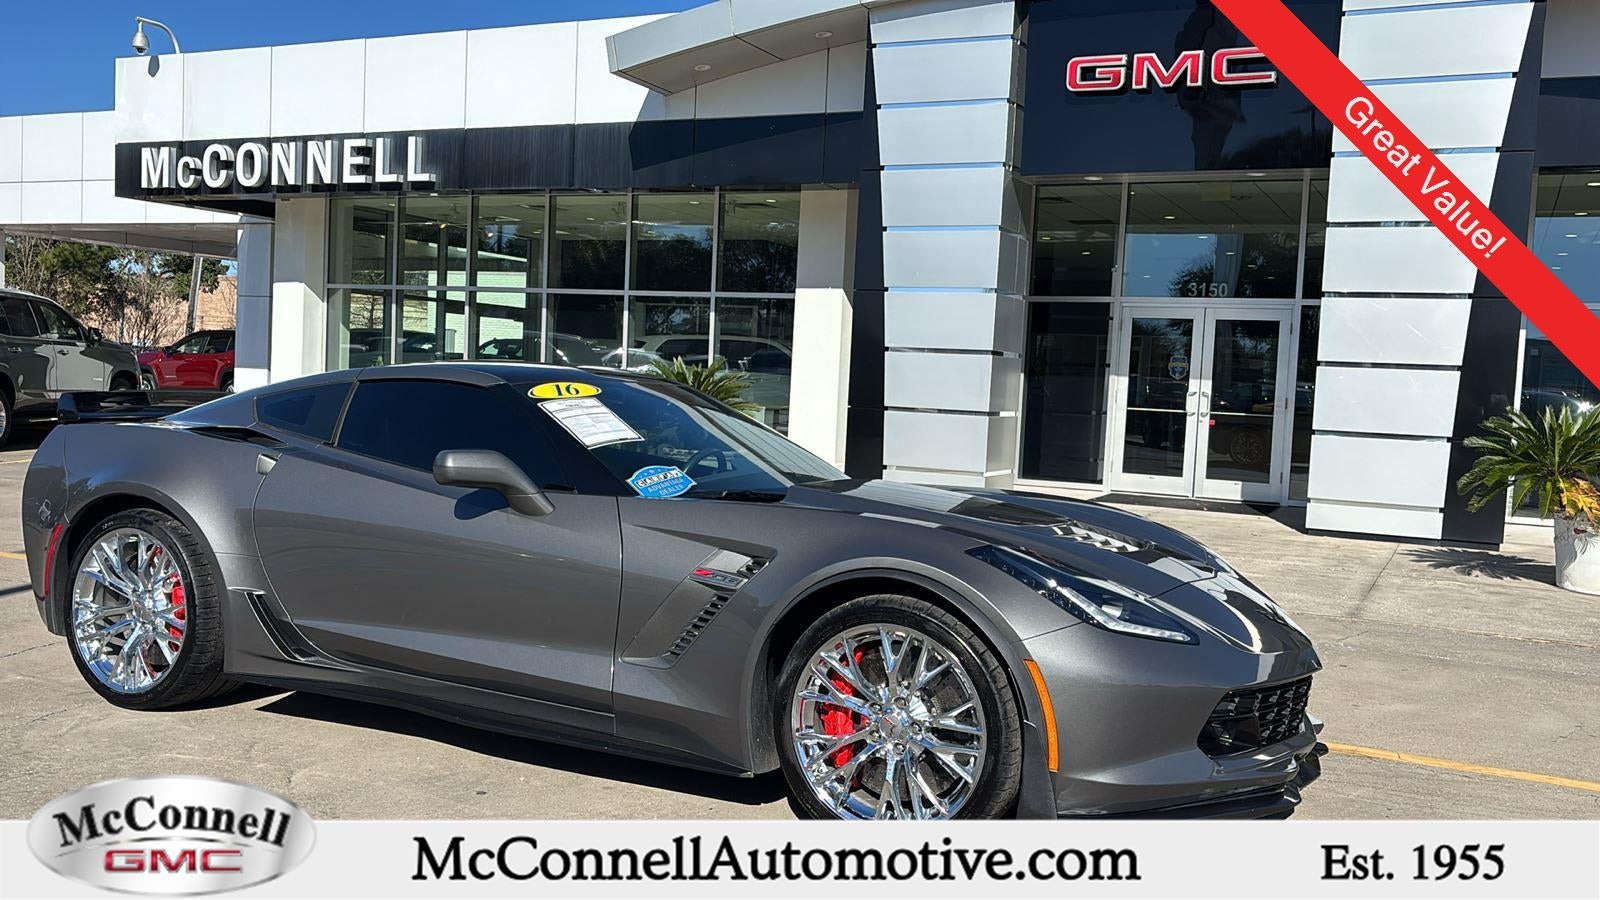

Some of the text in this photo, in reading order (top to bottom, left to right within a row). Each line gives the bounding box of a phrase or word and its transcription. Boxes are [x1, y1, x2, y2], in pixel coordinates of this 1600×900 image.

[1066, 46, 1278, 92] GMC
[141, 135, 436, 189] McCONNELL
[1187, 282, 1229, 297] 3150
[555, 384, 579, 396] 16
